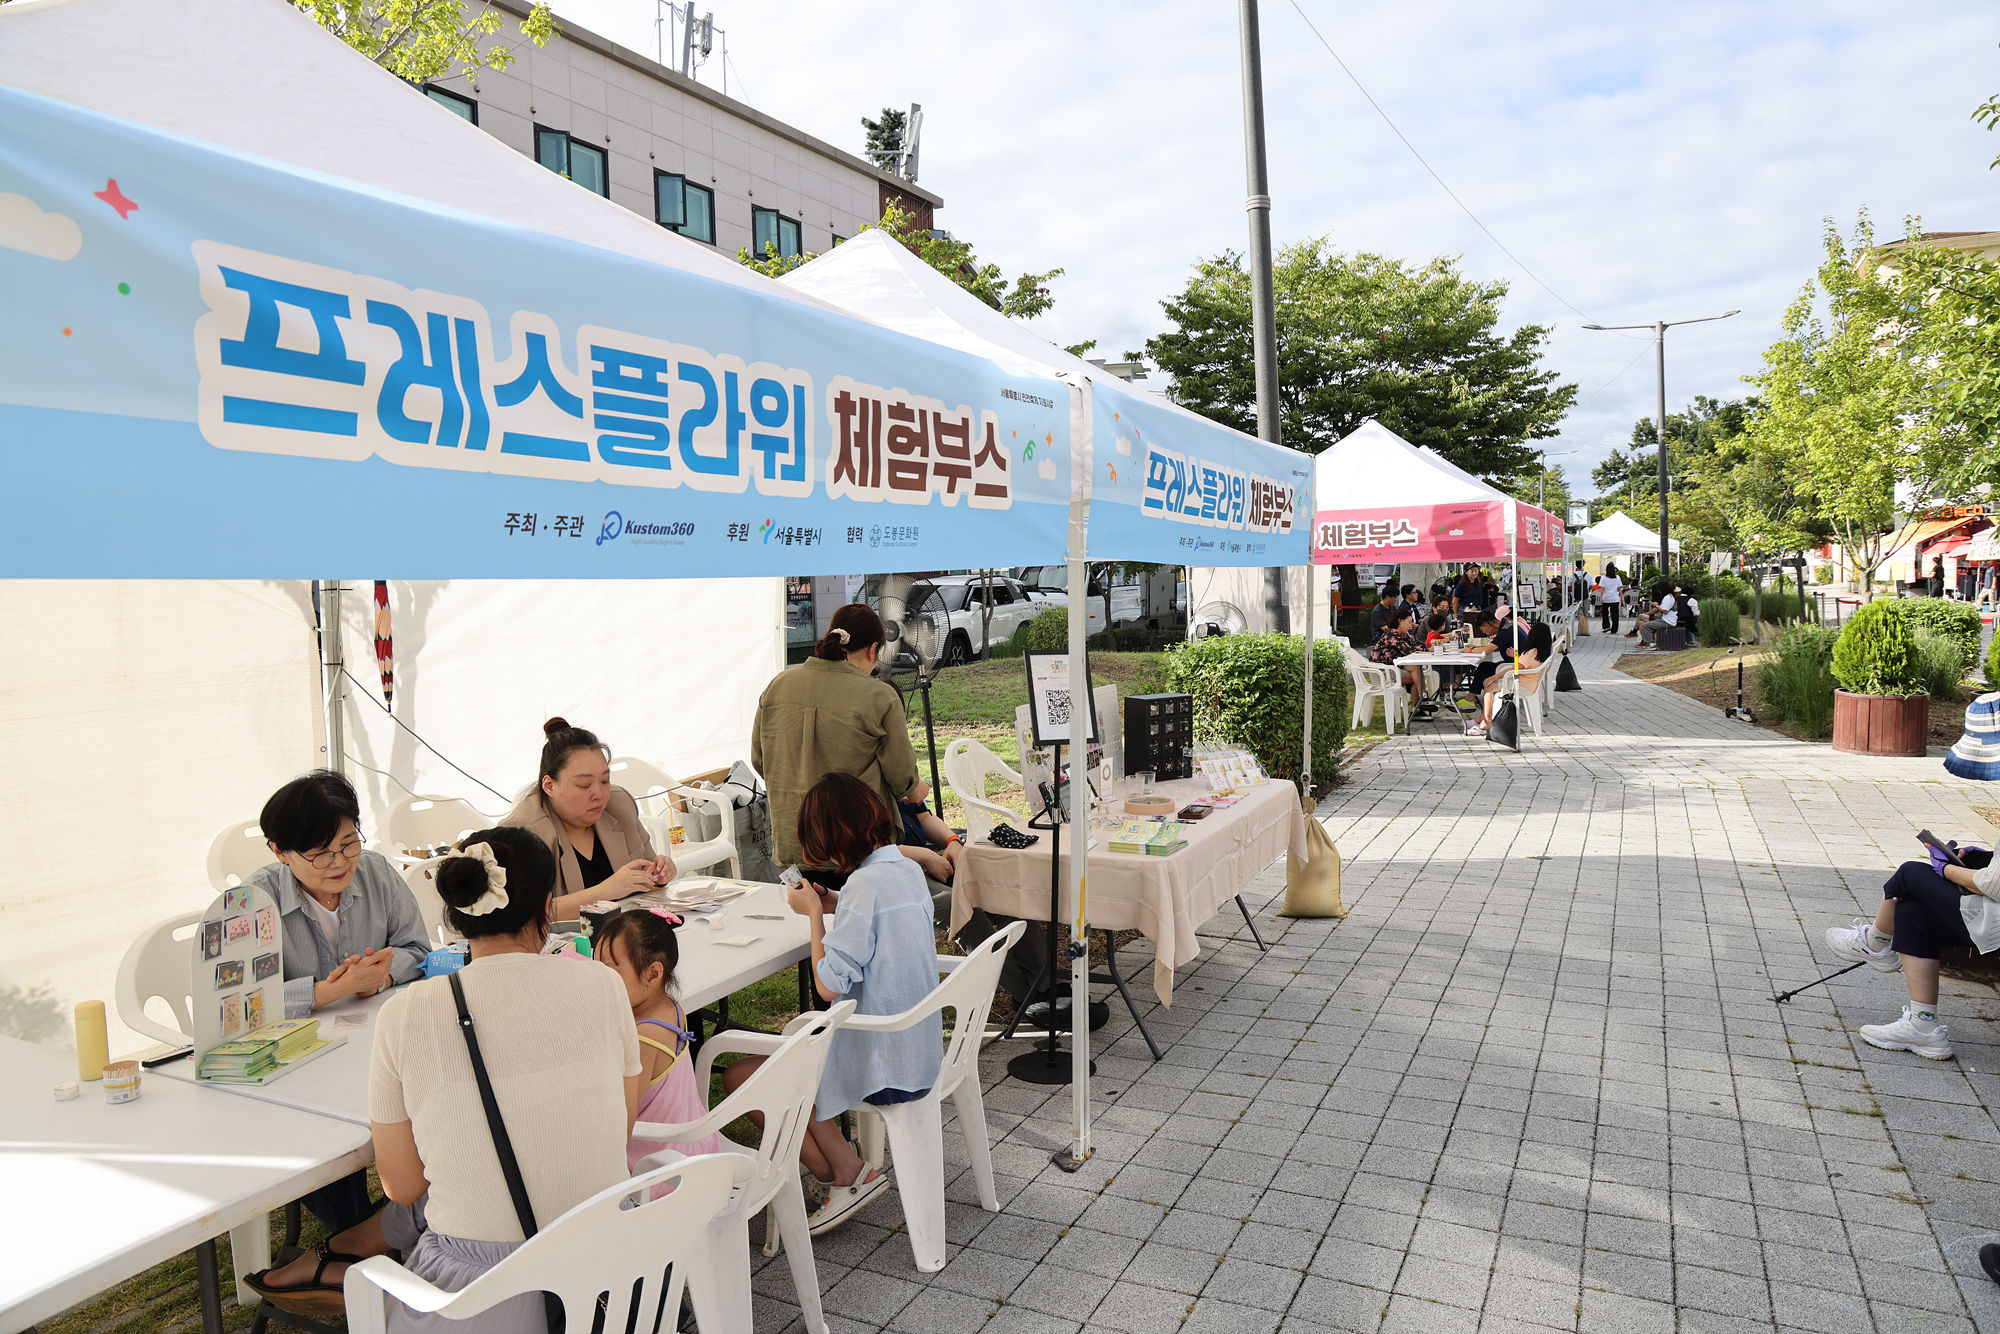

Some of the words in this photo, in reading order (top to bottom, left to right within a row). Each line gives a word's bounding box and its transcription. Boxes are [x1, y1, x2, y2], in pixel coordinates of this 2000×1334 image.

[217, 264, 806, 483] 프레스플라워
[833, 389, 1009, 499] 체험부스
[1144, 450, 1246, 524] 프레스플라워
[1248, 478, 1294, 529] 체험부스
[504, 512, 538, 537] 주최
[553, 515, 585, 538] 주관
[624, 520, 695, 536] Kustom360
[727, 522, 750, 542] 후원
[847, 526, 864, 544] 협력
[883, 526, 919, 541] 도봉문화원
[1321, 521, 1416, 548] 체험부스
[659, 538, 673, 546] Digital
[774, 526, 822, 546] 서울특별시
